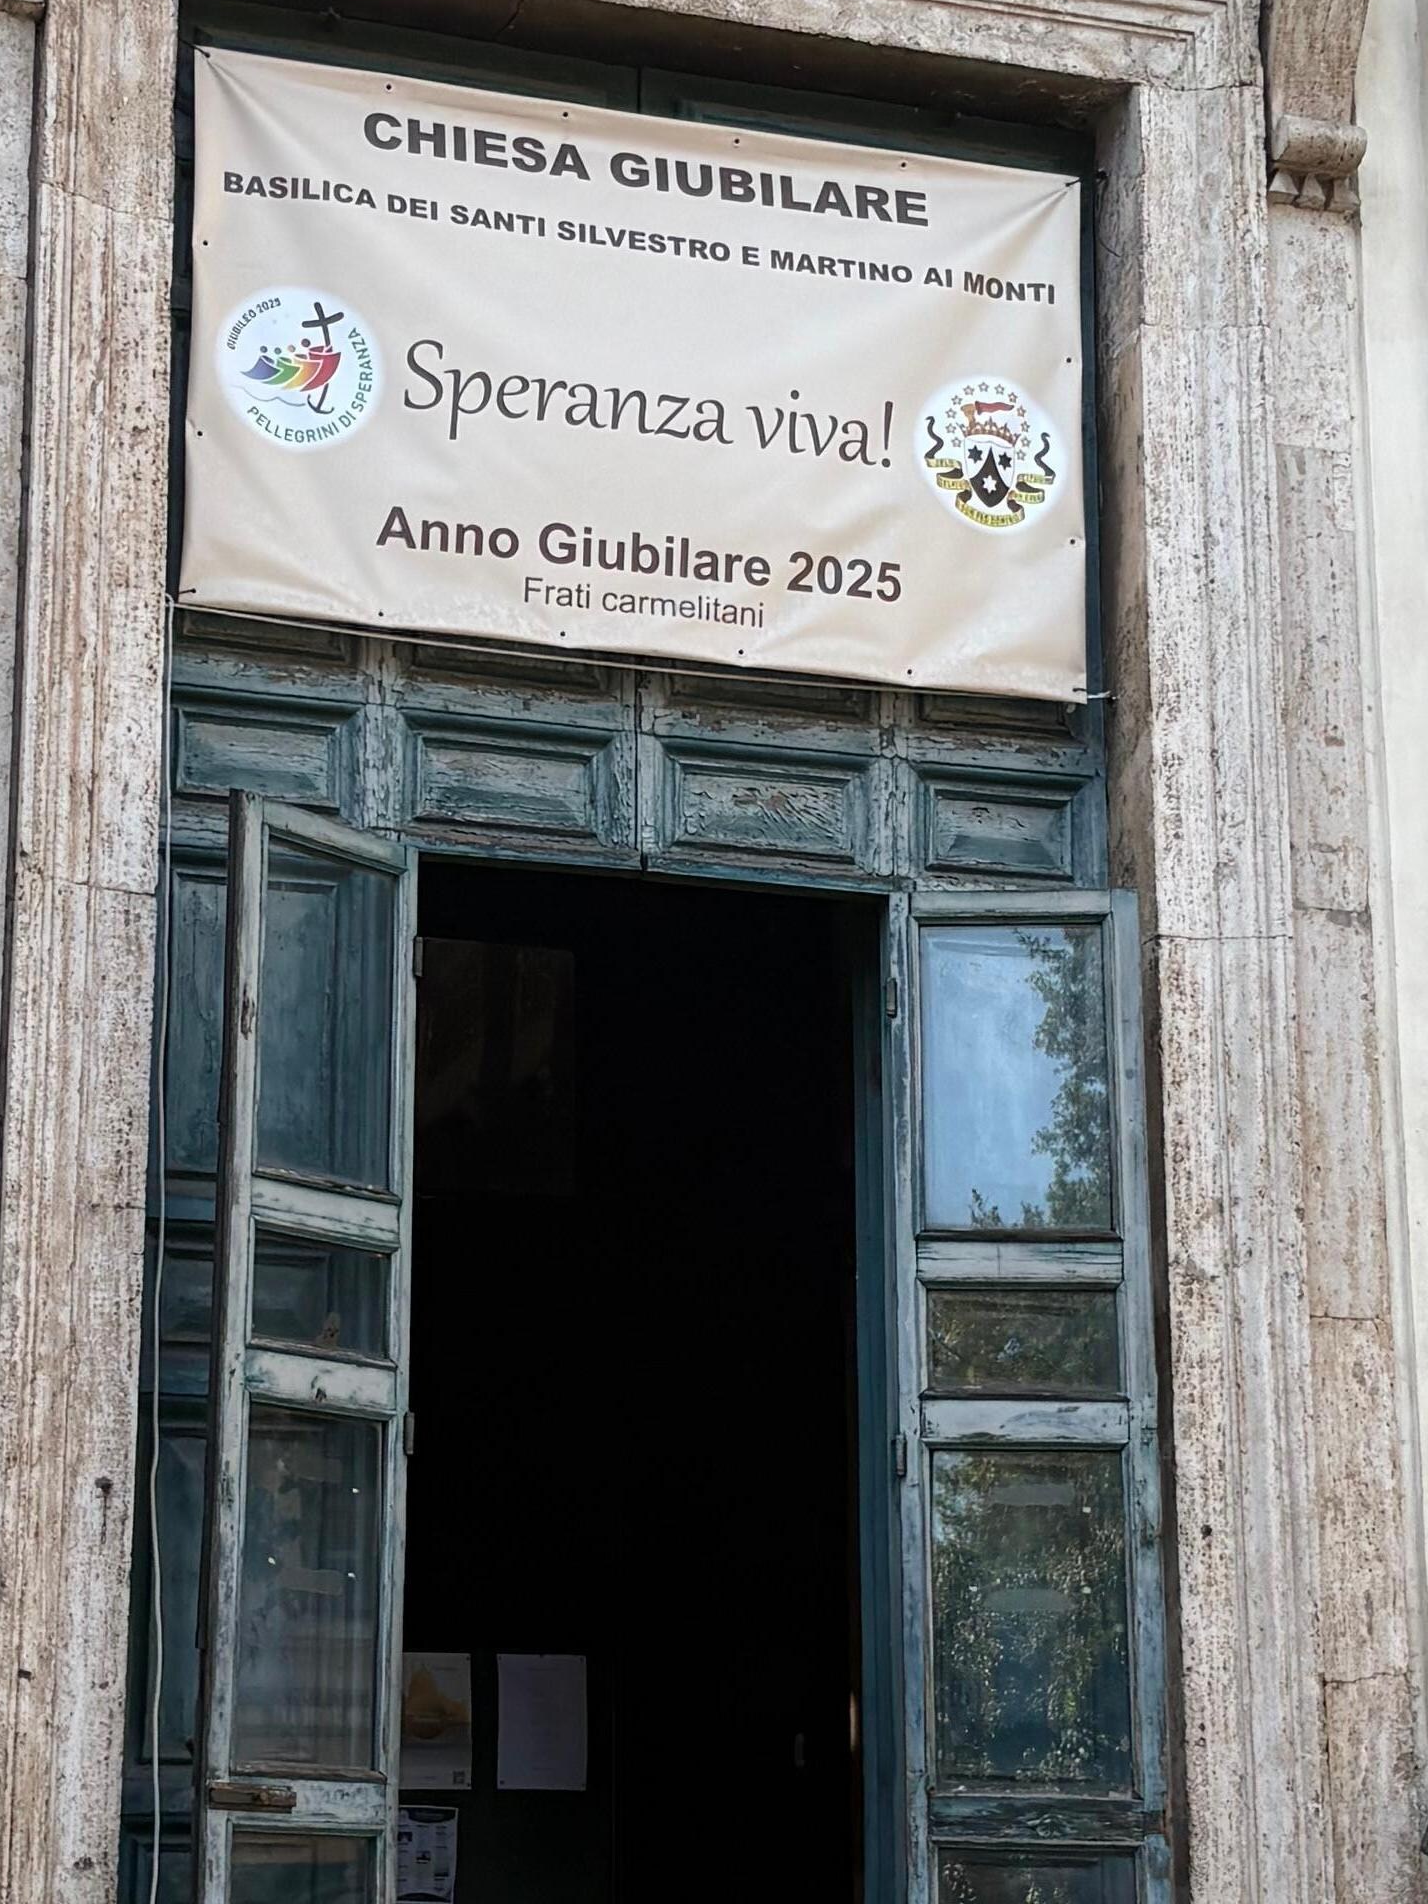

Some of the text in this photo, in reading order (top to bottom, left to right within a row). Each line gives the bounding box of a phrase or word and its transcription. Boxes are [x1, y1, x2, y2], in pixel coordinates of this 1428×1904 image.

[363, 112, 929, 226] CHIESA GIUBILARE
[224, 171, 1055, 304] BASILICA DEI SANTI SILVESTRO E MARTINO AI MONTI
[247, 327, 373, 443] PELLEGRINI DI SPERANZA
[403, 338, 894, 468] Speranza viva!
[375, 506, 903, 603] Anno Giubilare 2025
[524, 576, 765, 628] Frati carmelitani
